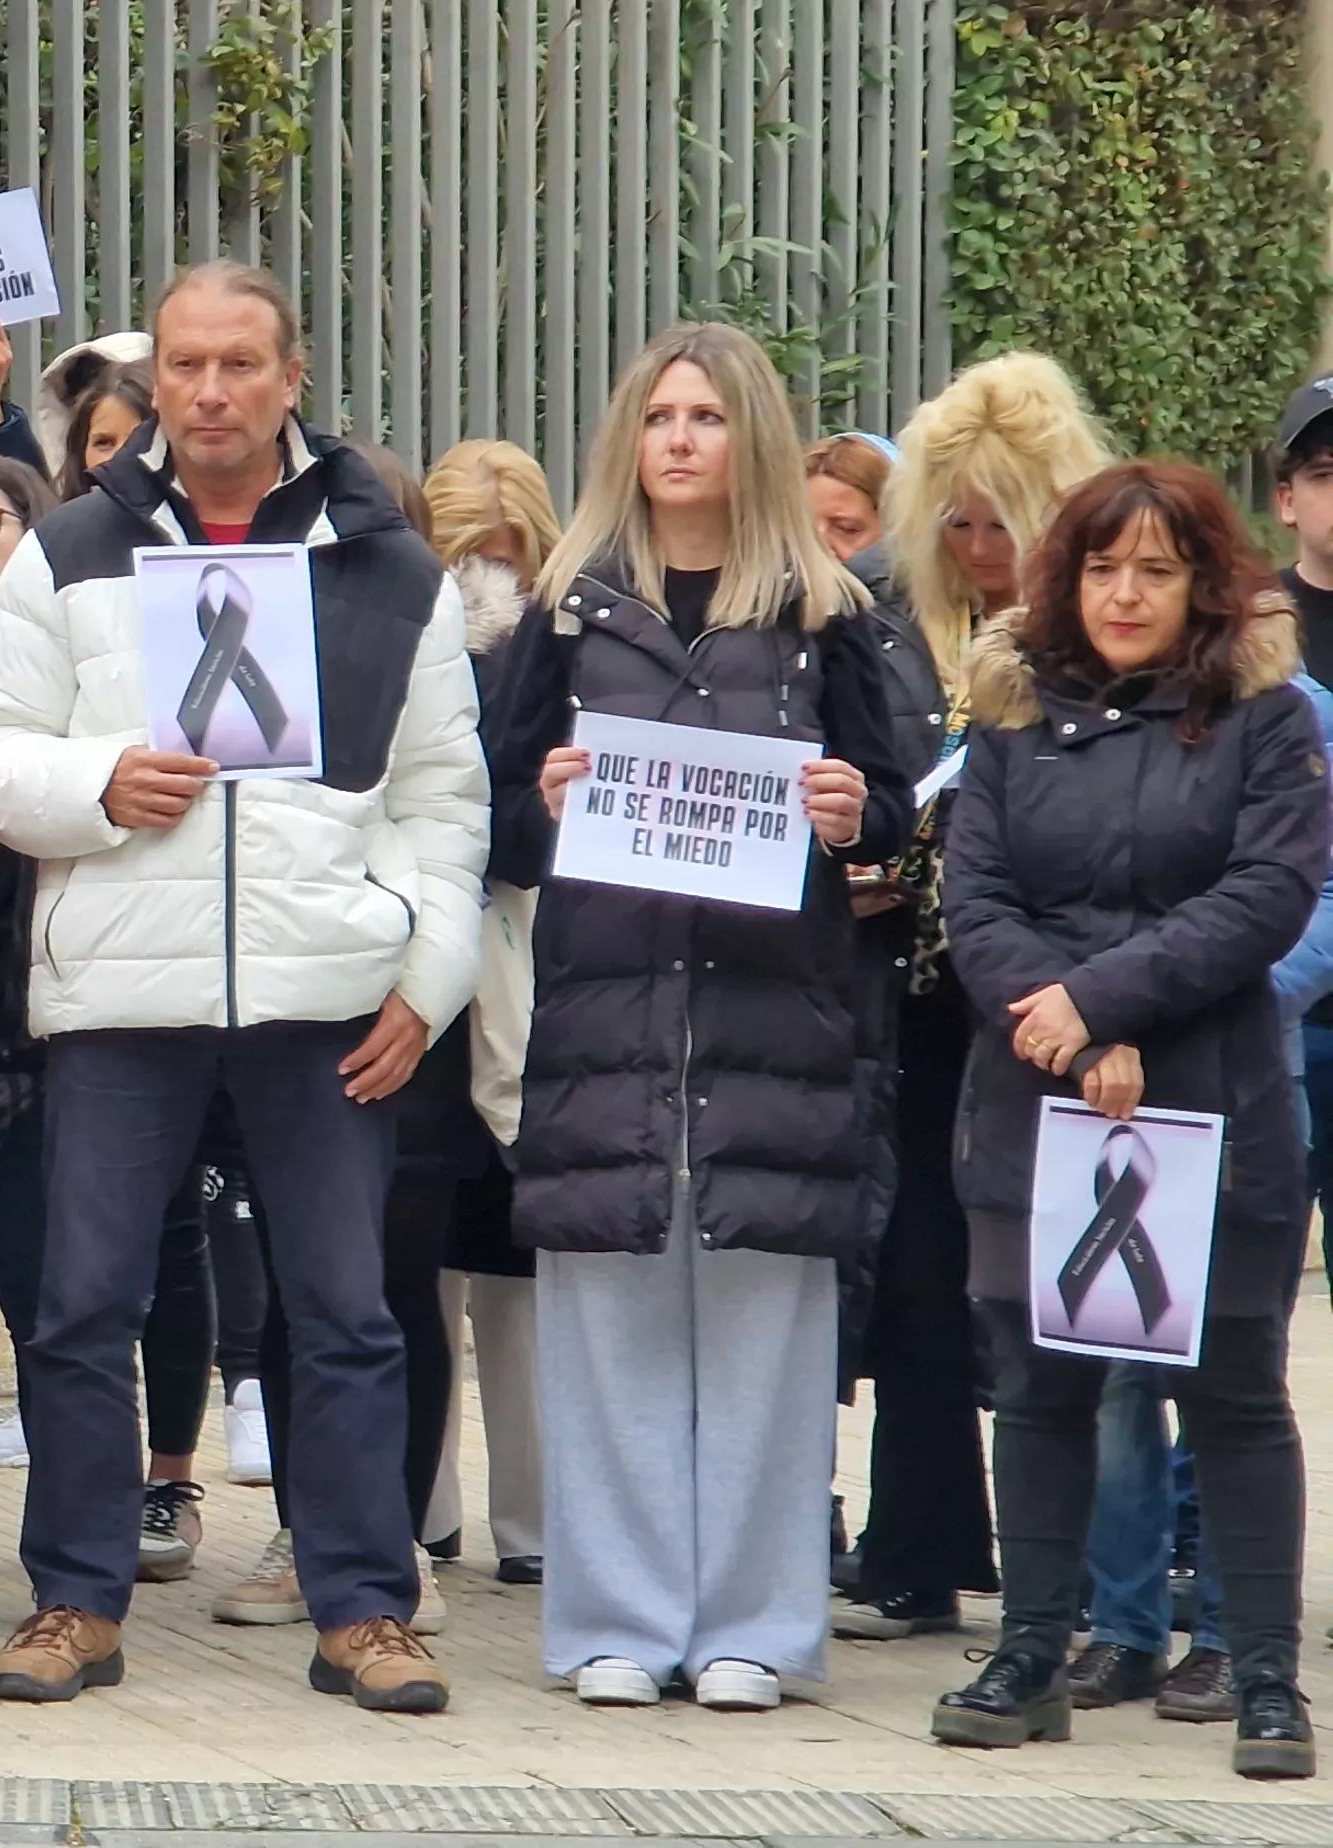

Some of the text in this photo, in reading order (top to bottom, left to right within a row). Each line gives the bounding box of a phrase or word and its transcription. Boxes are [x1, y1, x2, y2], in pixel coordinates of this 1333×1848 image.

[596, 752, 790, 807] QUE LA VOCACIÓN
[585, 785, 789, 842] NO SE ROMPA POR
[631, 827, 733, 869] EL MIEDO
